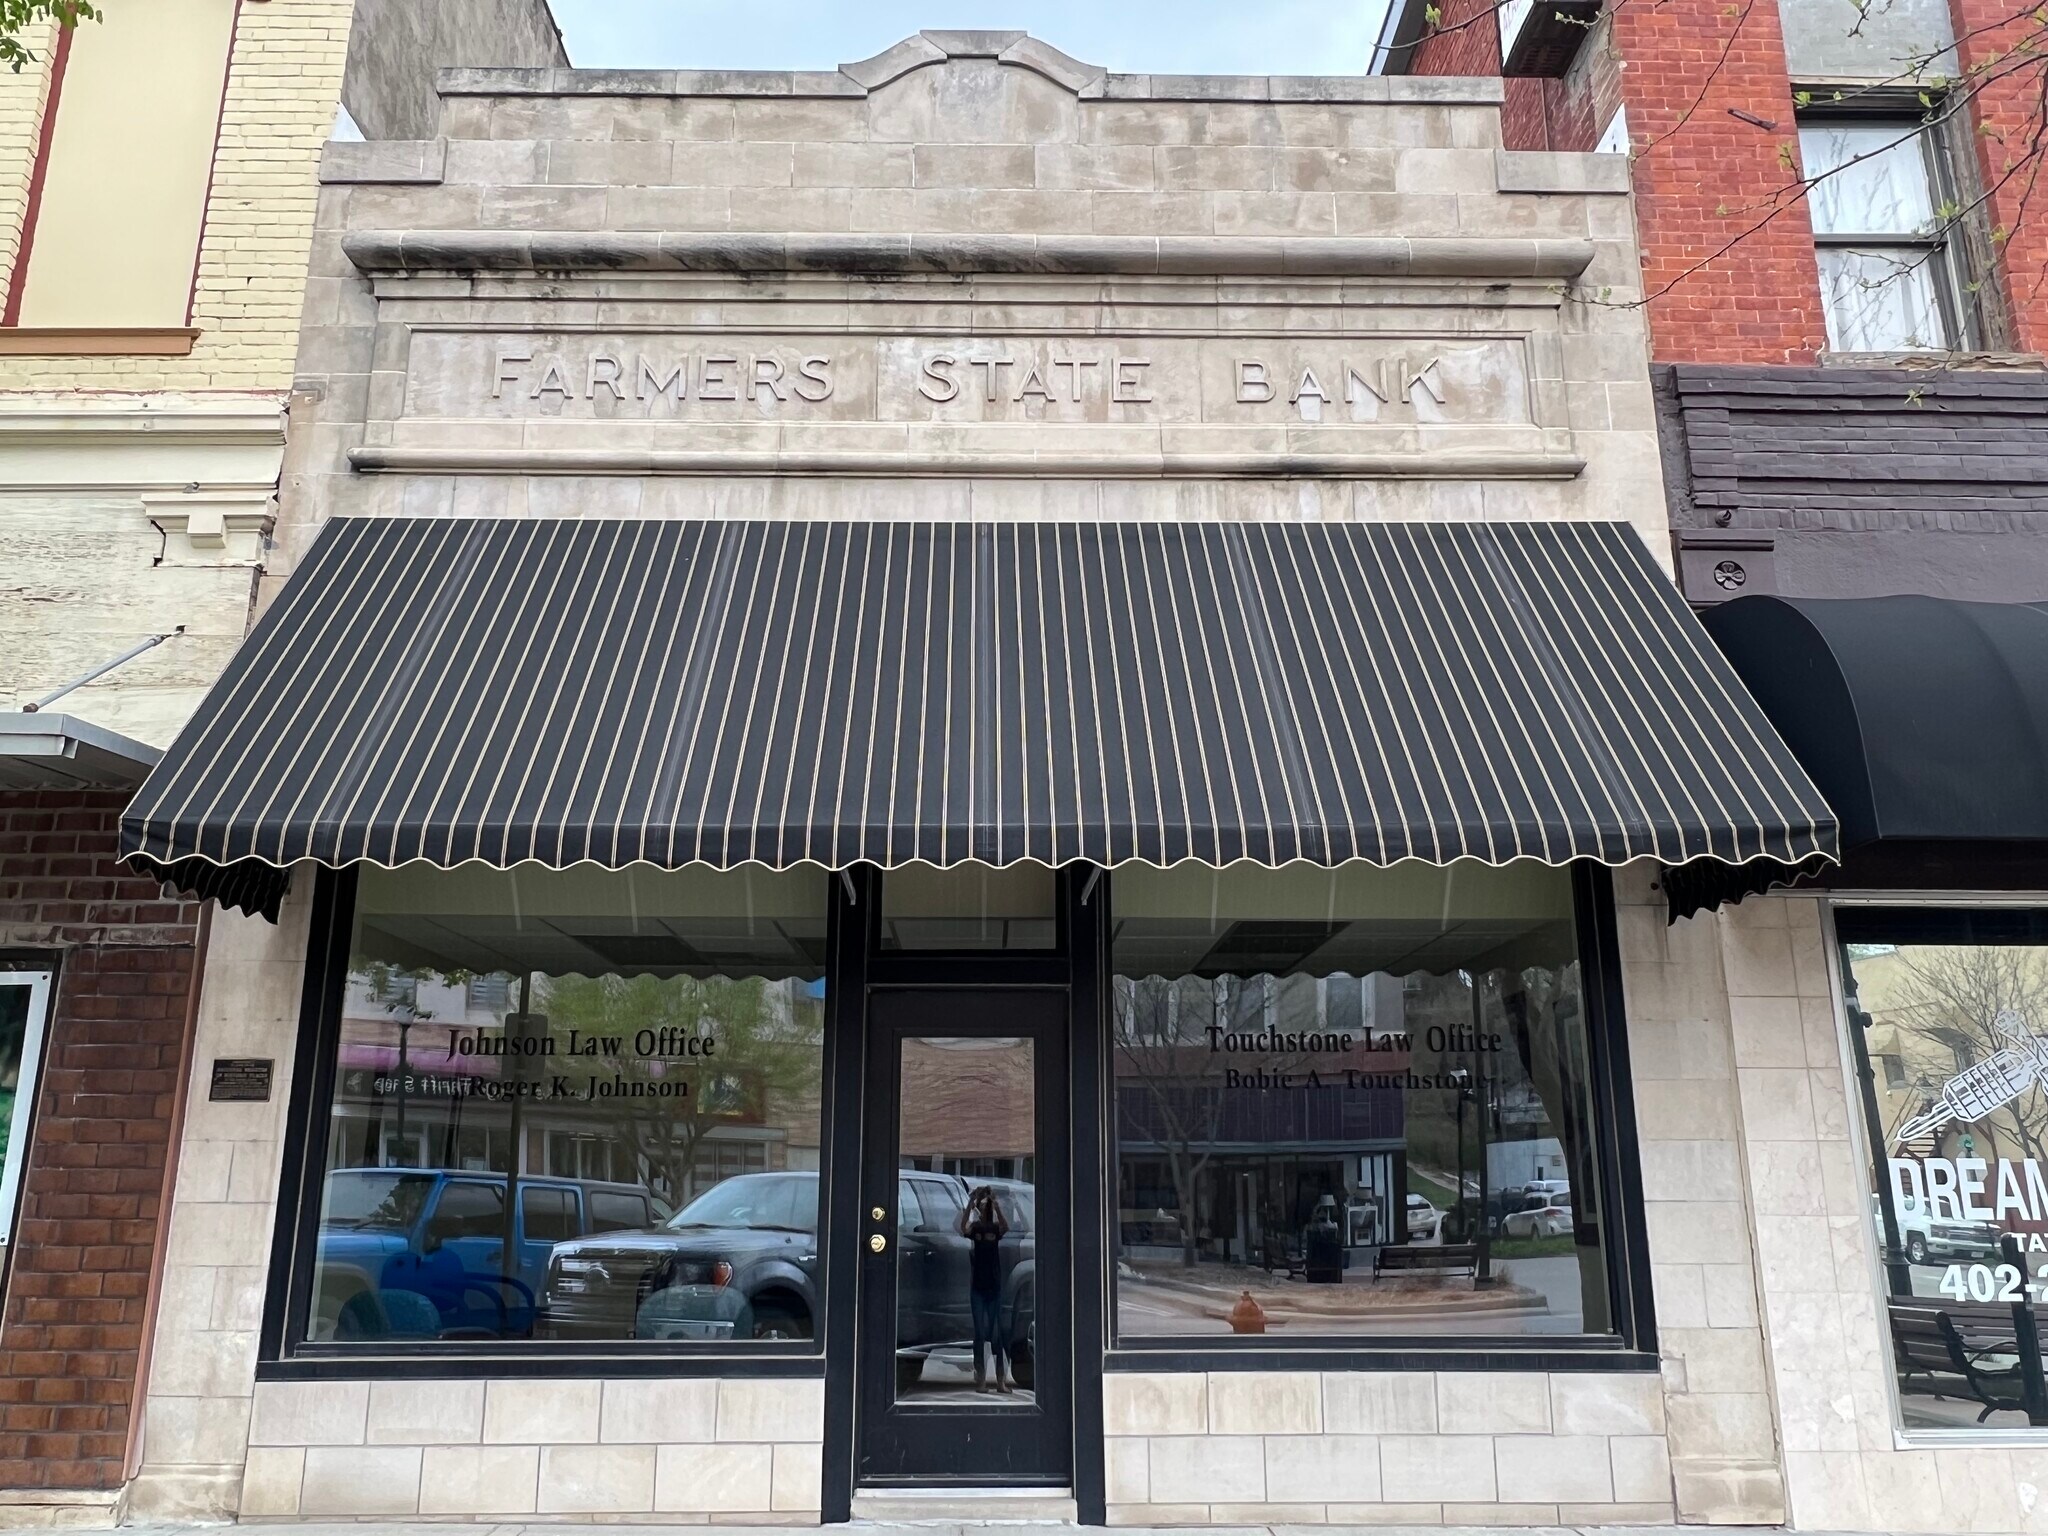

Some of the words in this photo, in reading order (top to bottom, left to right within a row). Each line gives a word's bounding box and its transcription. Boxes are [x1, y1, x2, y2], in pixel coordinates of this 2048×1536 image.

[492, 353, 835, 402] FARMERS
[918, 353, 1153, 403] STATE
[1233, 357, 1446, 405] BANK
[447, 1027, 555, 1062] Johnson
[567, 1029, 622, 1057] Law
[634, 1026, 716, 1058] Office
[1205, 1023, 1352, 1053] Touchstone
[1363, 1025, 1414, 1053] Law
[1426, 1023, 1503, 1053] Office
[469, 1075, 543, 1102] Roger
[551, 1076, 577, 1098] K.
[587, 1074, 689, 1102] Johnson
[1225, 1067, 1293, 1090] Bobie
[1342, 1067, 1490, 1091] Touchstone
[2012, 1233, 2048, 1253] TA
